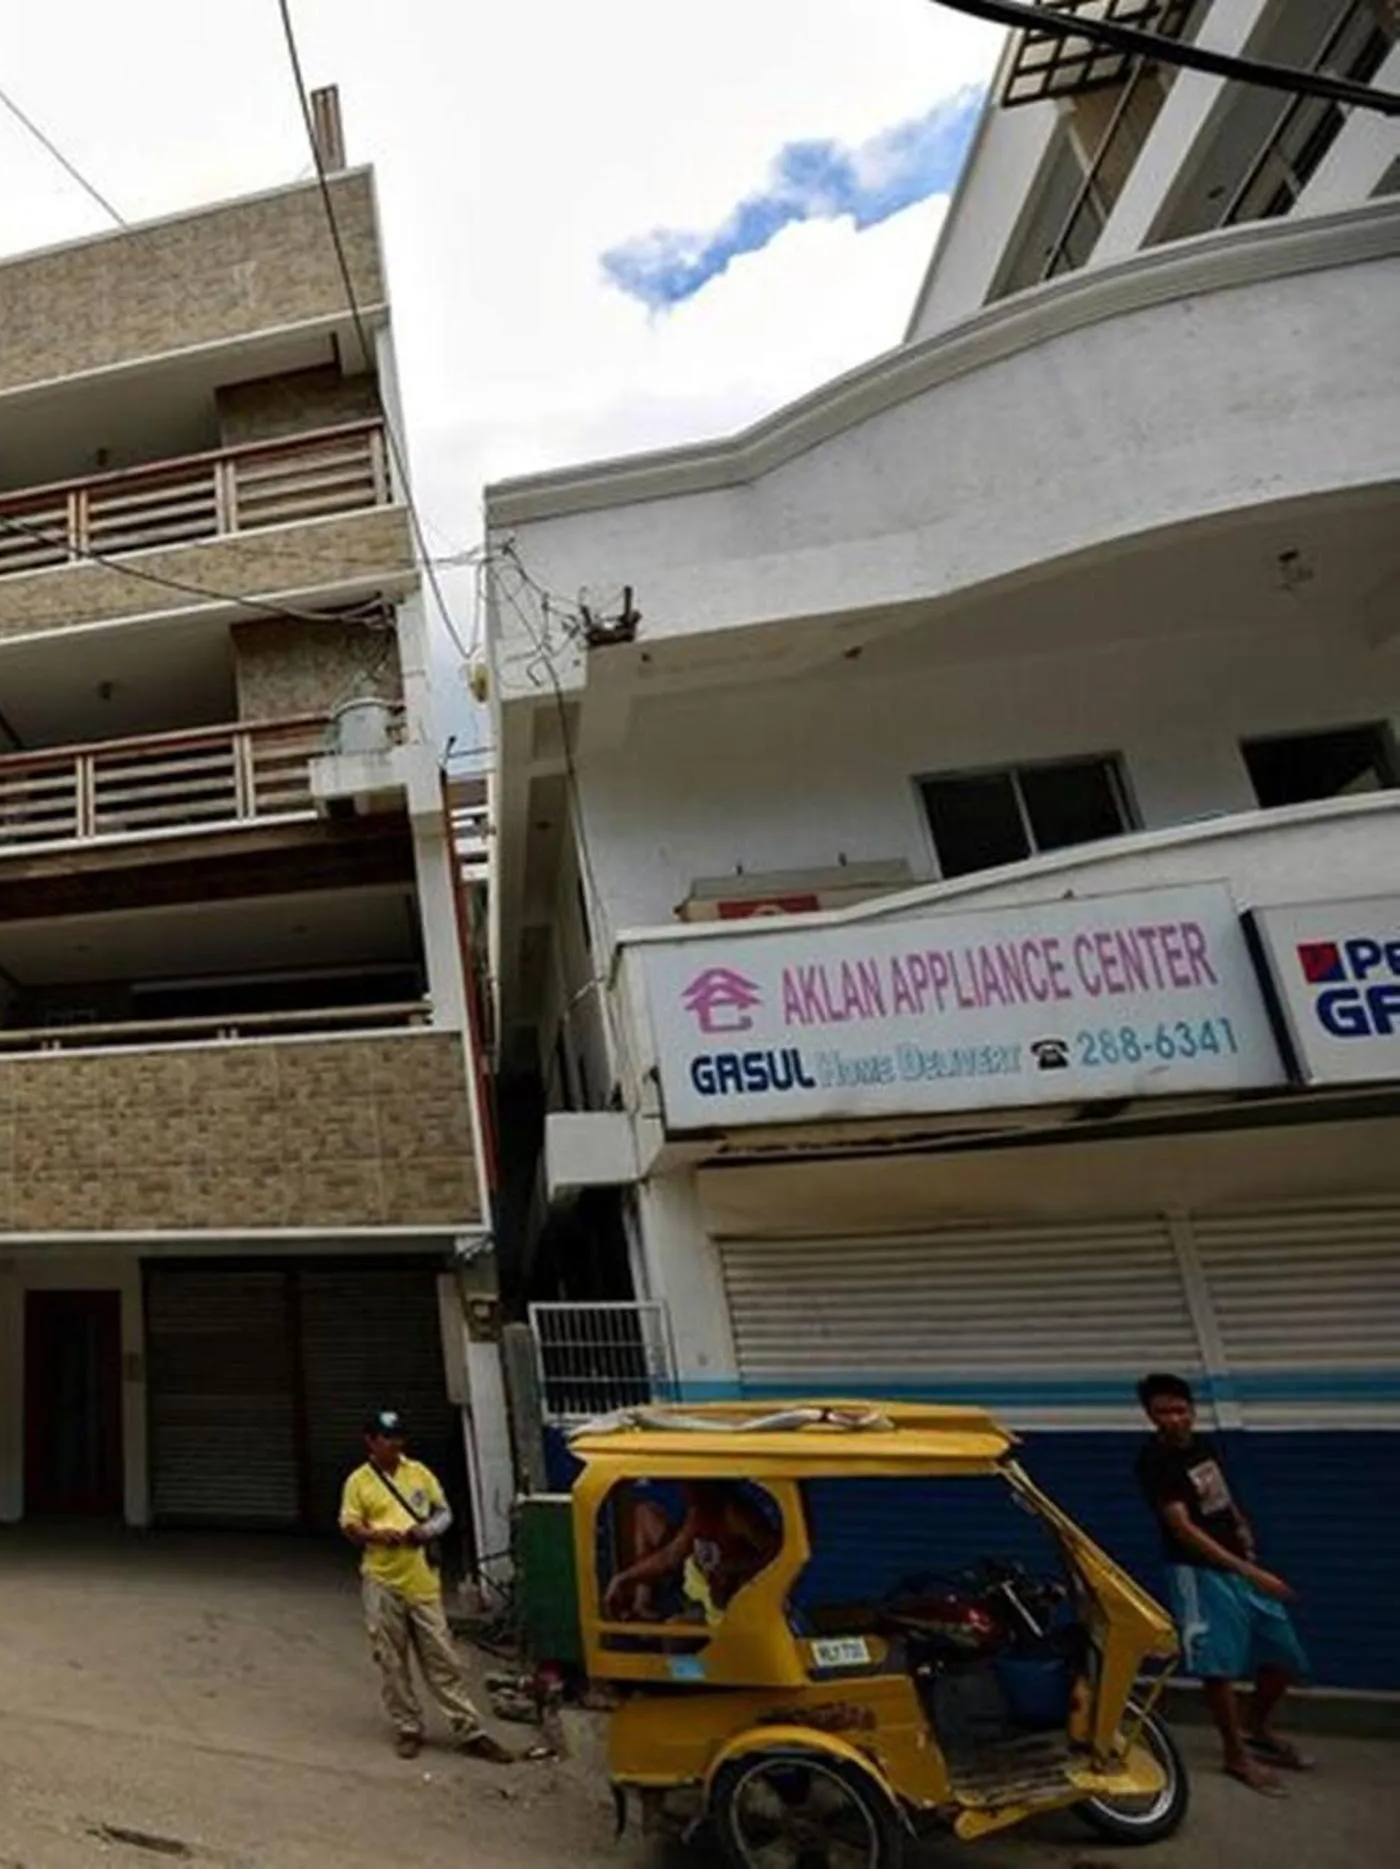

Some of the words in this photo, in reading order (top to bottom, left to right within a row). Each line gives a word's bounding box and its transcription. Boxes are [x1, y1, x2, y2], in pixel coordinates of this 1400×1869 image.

[781, 956, 887, 1027] AKLAN
[889, 936, 1072, 1016] APPLIANCE
[1073, 921, 1219, 998] CENTER
[690, 1047, 816, 1095] GASUL
[1075, 1016, 1238, 1067] 288-6341
